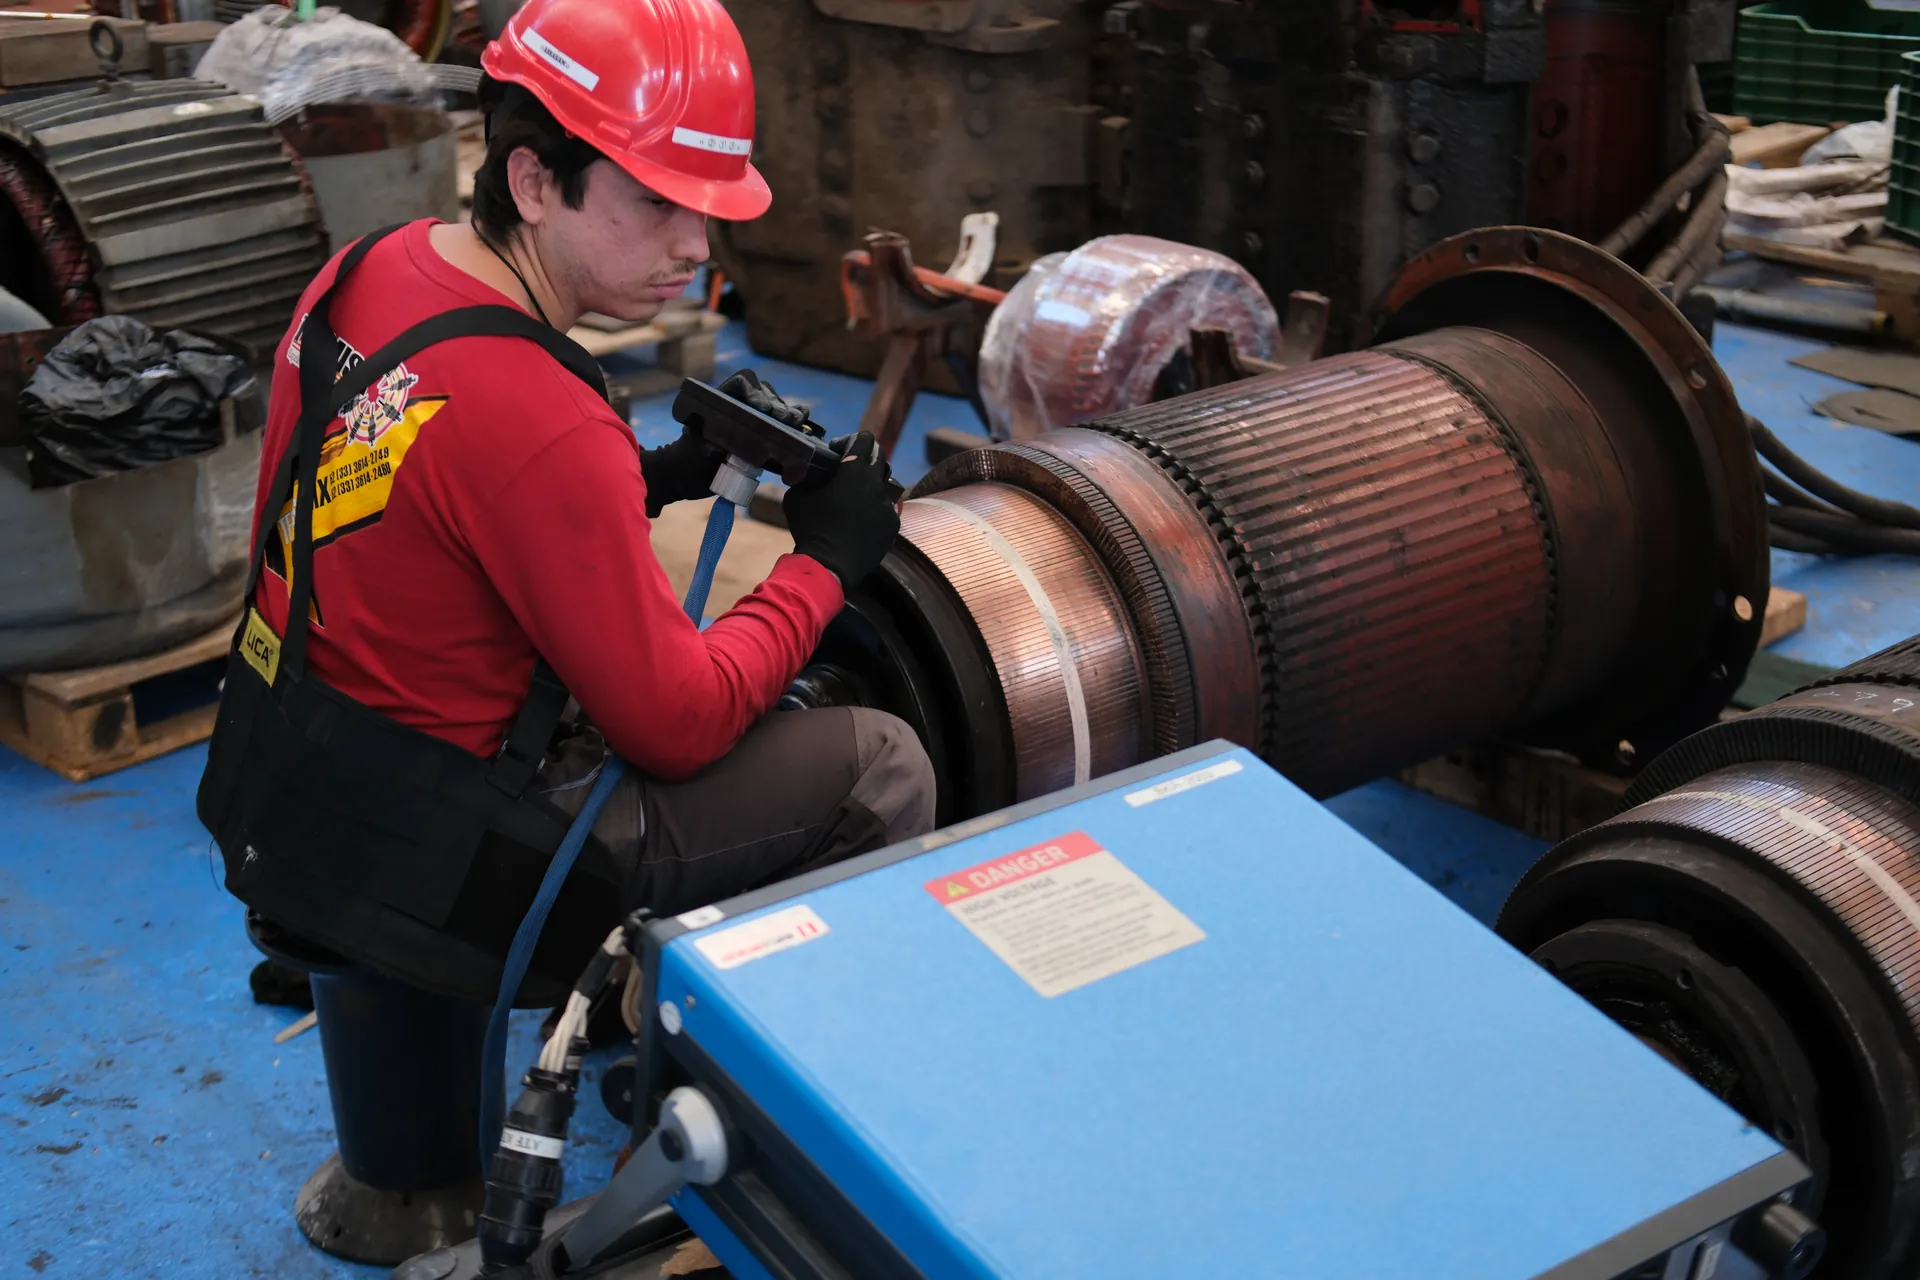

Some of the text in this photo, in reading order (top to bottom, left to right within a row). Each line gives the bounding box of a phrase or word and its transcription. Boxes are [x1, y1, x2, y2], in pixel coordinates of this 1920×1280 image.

[336, 464, 352, 481] (33)
[353, 446, 390, 473] 3614-2749
[337, 479, 355, 496] (33)
[968, 845, 1070, 889] DANGER
